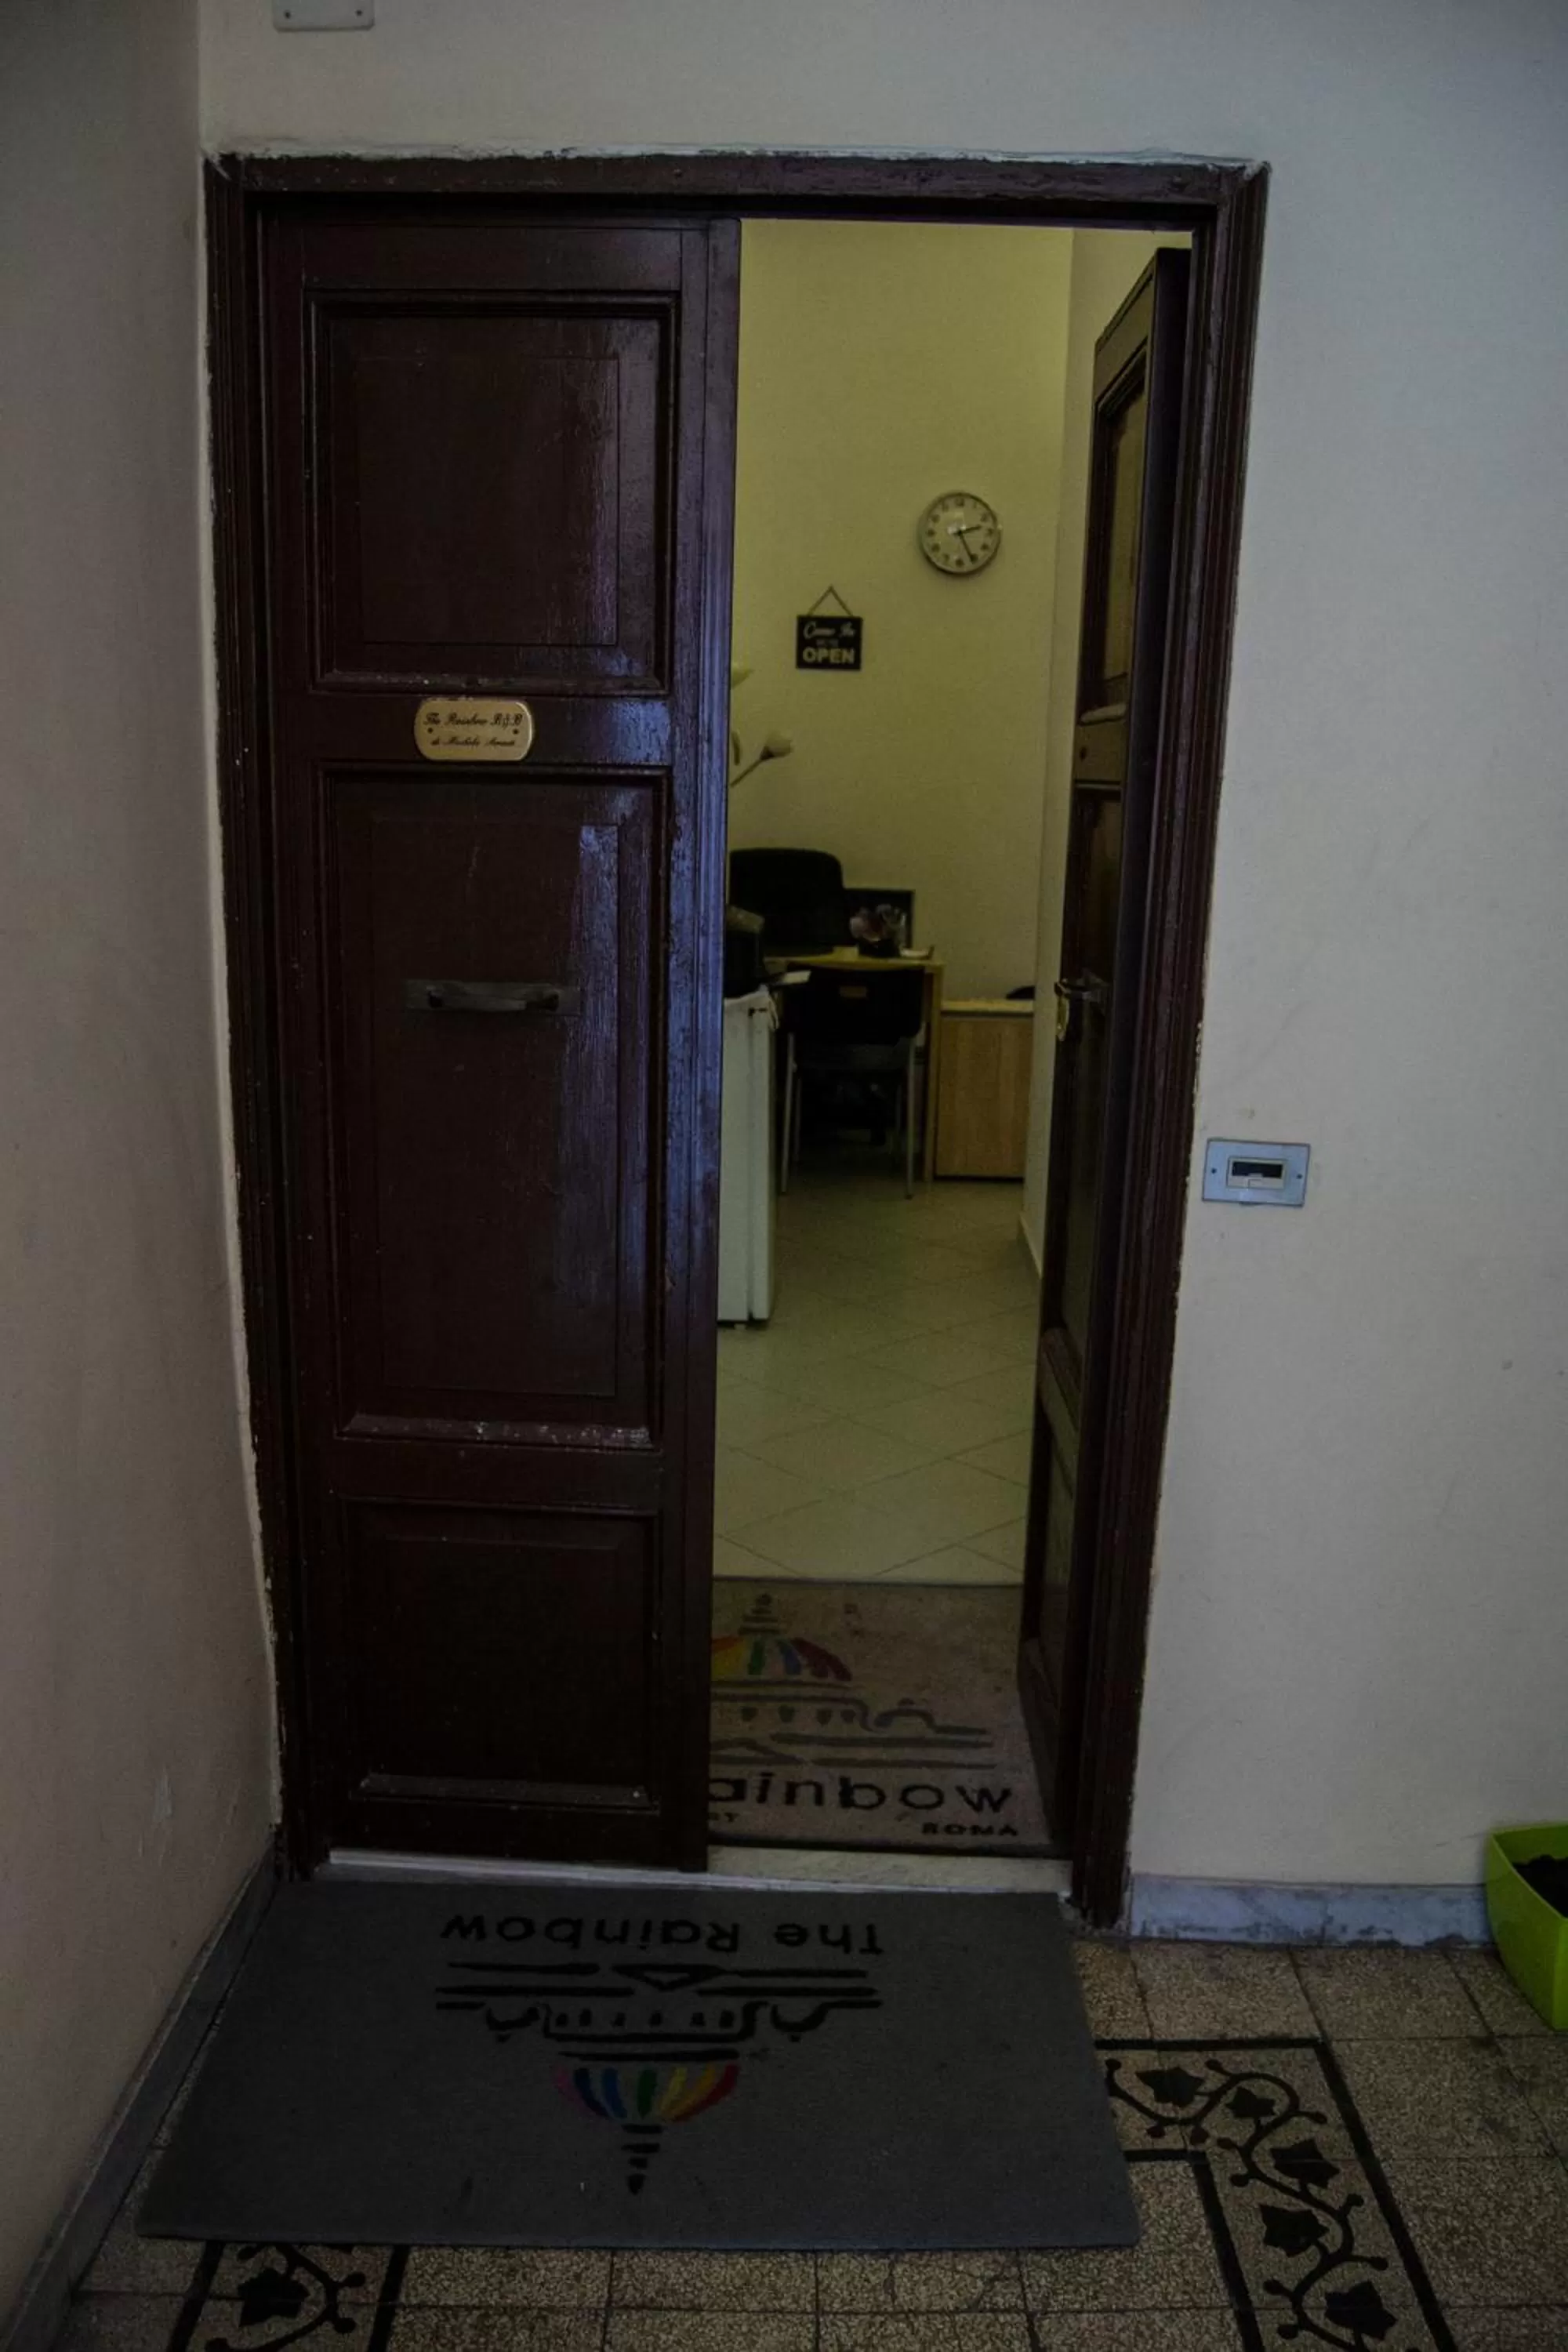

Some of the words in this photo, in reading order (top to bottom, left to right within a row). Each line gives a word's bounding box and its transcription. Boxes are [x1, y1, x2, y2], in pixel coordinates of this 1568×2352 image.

[803, 647, 855, 664] OPEN
[710, 1772, 1012, 1814] ainbow
[921, 1821, 1018, 1836] ROMA
[441, 1915, 742, 1954] Rainbow
[774, 1922, 884, 1955] The
